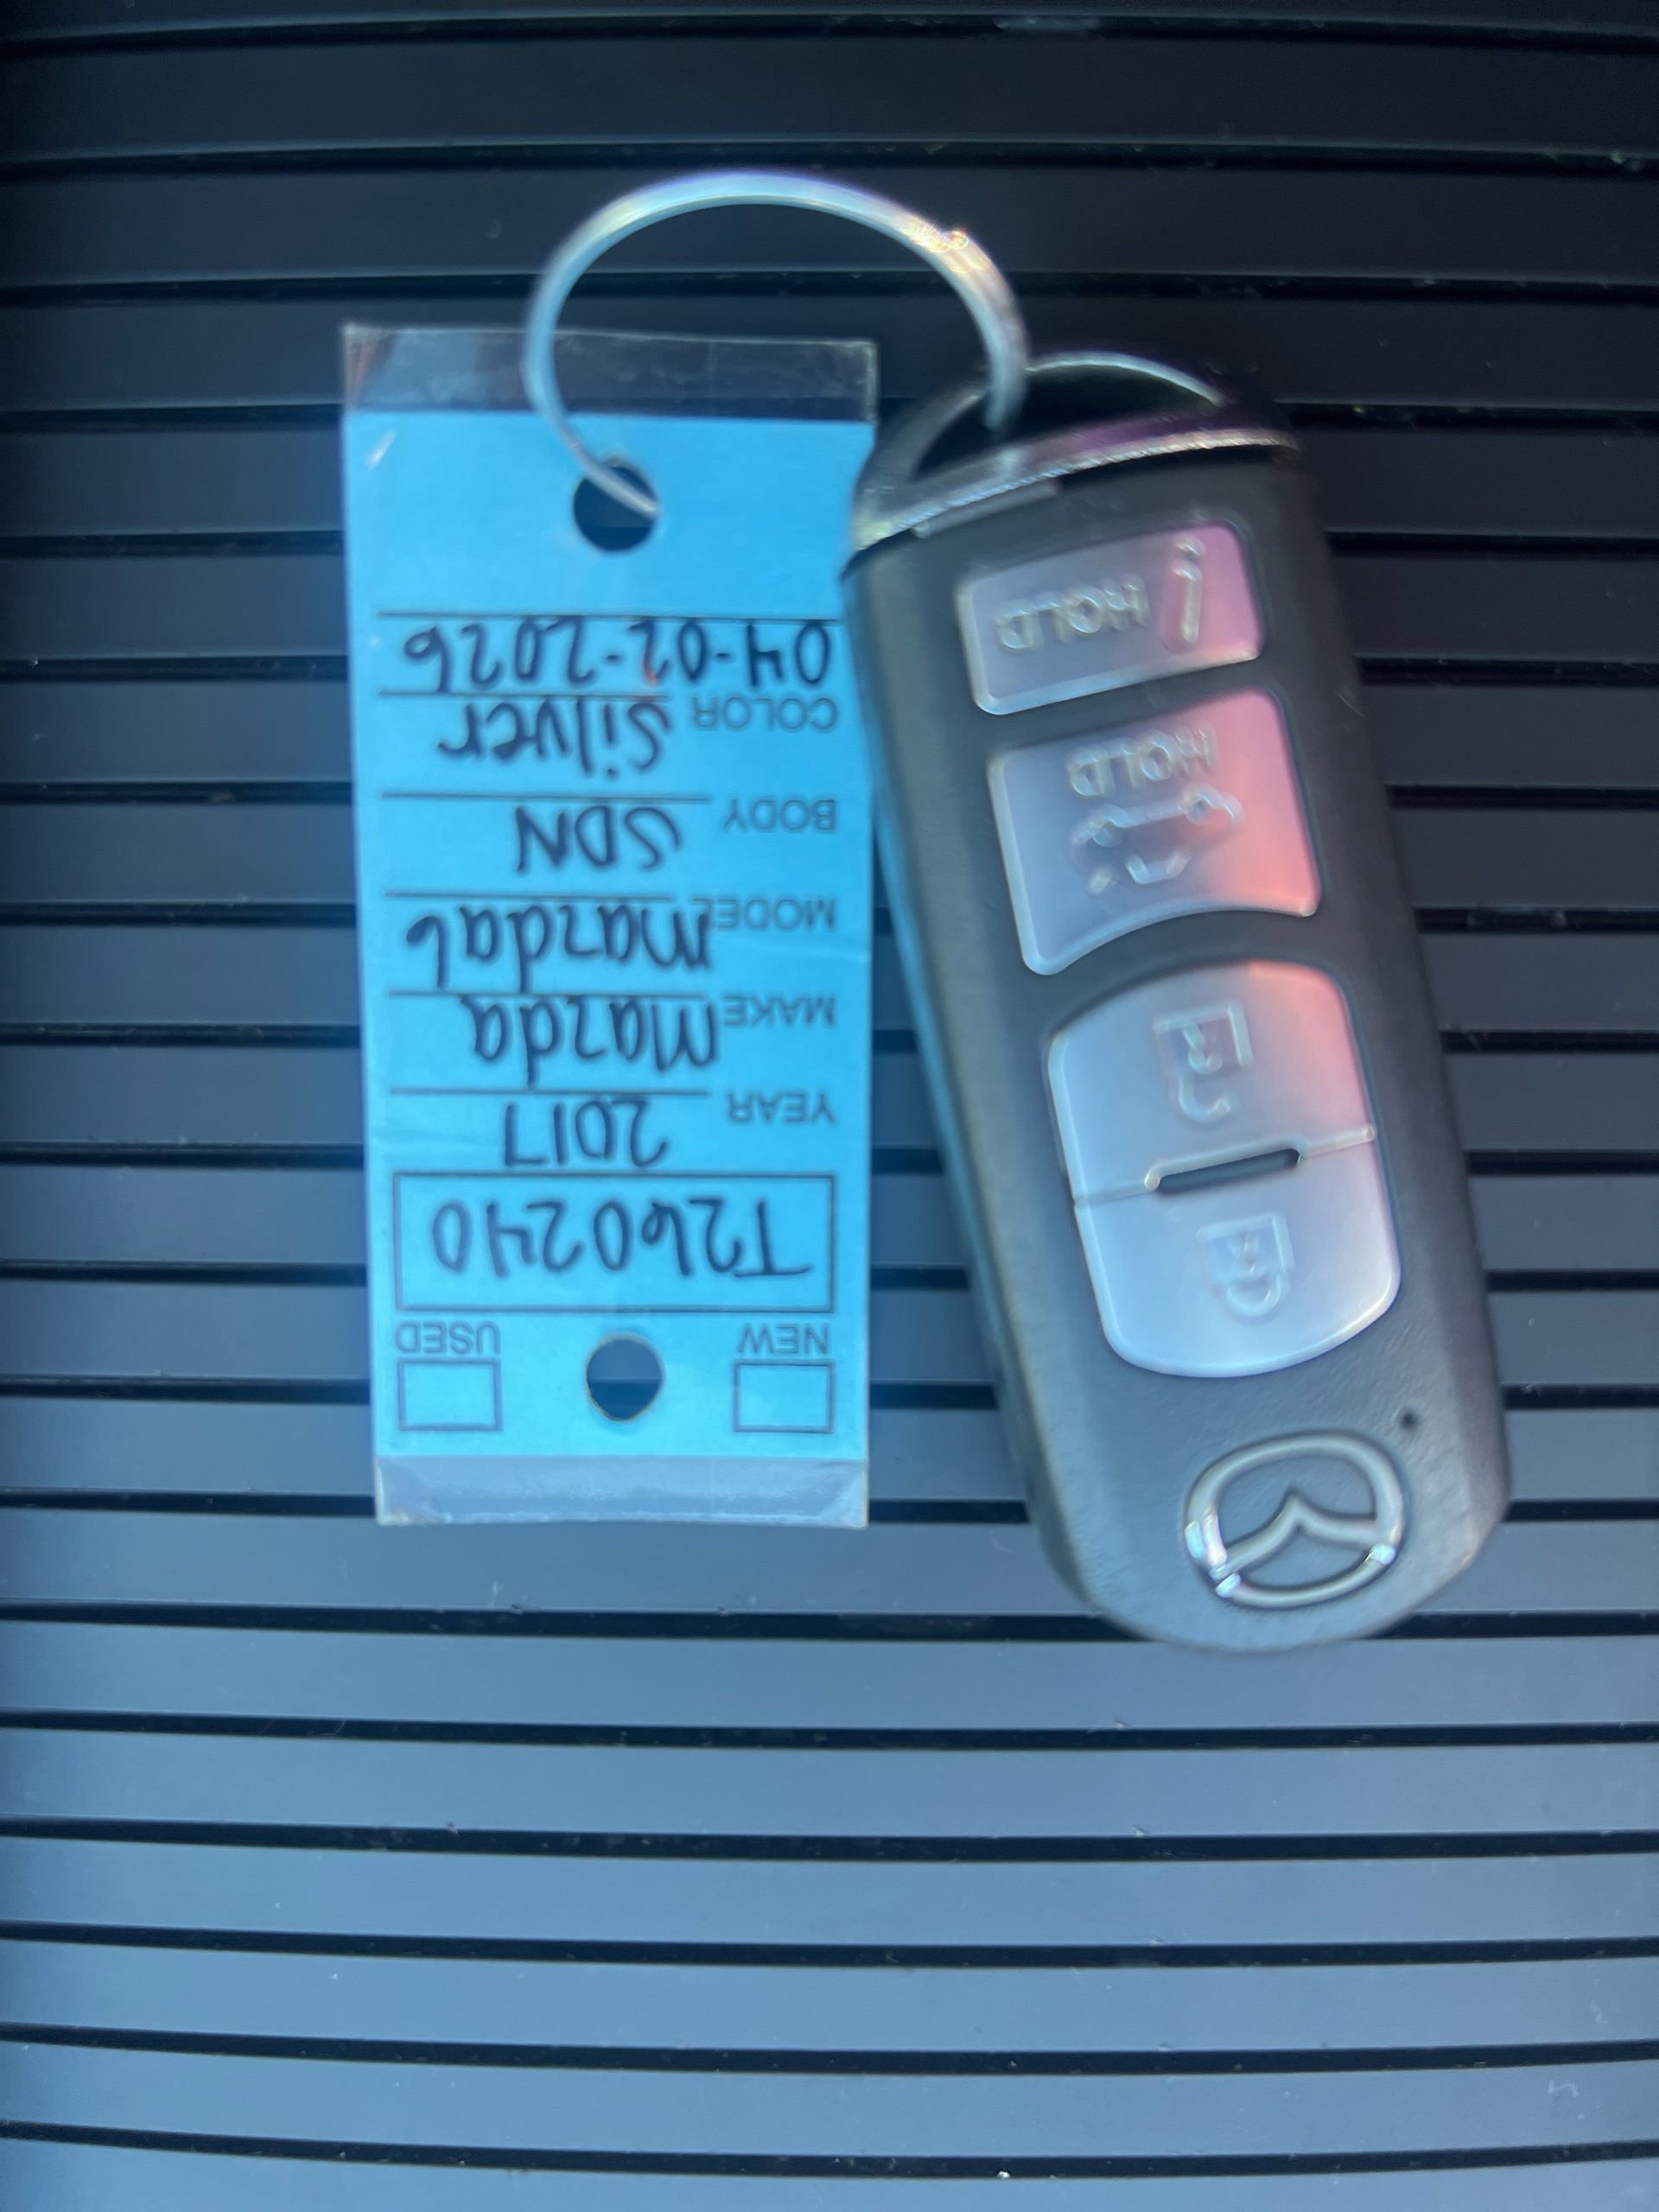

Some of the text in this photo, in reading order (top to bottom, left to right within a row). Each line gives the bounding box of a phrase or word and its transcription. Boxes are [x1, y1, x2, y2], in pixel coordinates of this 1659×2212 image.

[998, 573, 1150, 650] HOLD
[404, 614, 831, 693] 04-02-2026
[437, 698, 671, 781] Silver
[690, 696, 839, 732] COLOR
[1066, 722, 1217, 798] HOLD
[513, 804, 682, 877] SDN
[721, 798, 837, 834] BODY
[690, 897, 838, 933] MODEL
[718, 995, 837, 1028] MAKE
[503, 1095, 671, 1168] 2017
[728, 1092, 835, 1122] YEAR
[431, 1198, 812, 1279] T260240
[395, 1322, 501, 1355] USED
[737, 1324, 831, 1354] NEW
